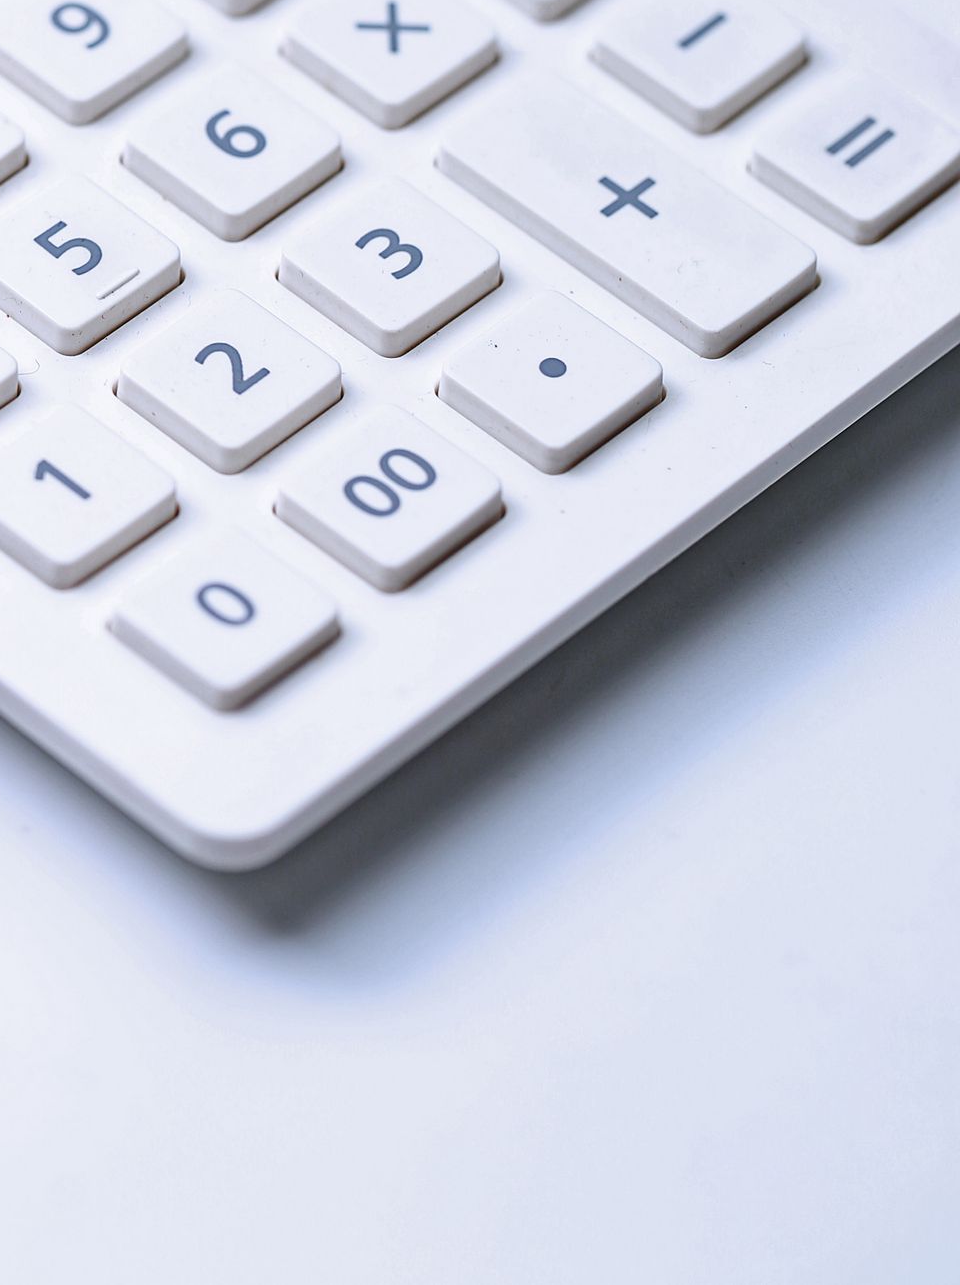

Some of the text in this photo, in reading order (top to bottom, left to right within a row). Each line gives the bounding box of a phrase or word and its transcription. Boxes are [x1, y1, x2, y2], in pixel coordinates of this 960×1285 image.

[50, 2, 110, 49] 9
[205, 110, 267, 158] 6
[33, 221, 102, 275] 5
[355, 228, 423, 279] 3
[195, 343, 270, 395] 2
[34, 459, 91, 500] 1
[343, 449, 437, 517] 00
[195, 582, 256, 627] 0
